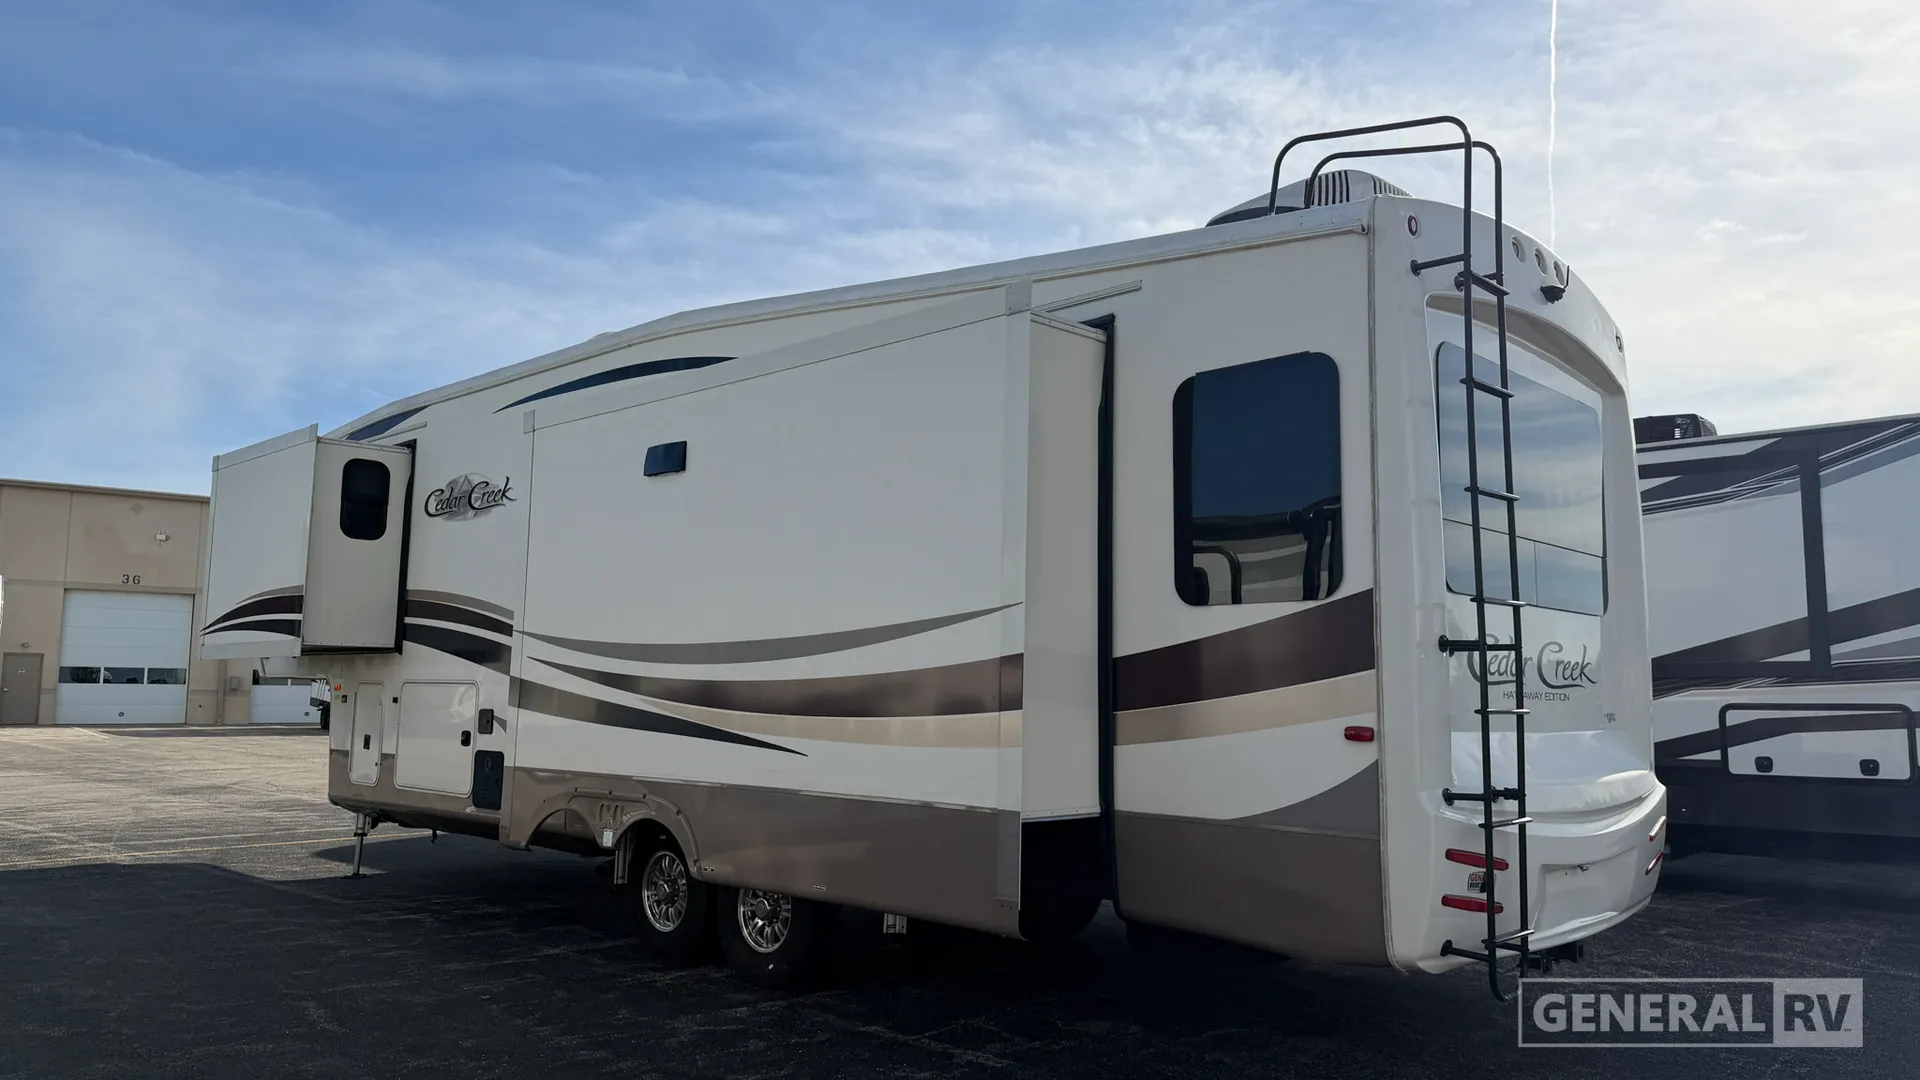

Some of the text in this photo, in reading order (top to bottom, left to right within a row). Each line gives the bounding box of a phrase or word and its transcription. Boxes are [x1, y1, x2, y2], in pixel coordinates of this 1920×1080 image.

[424, 475, 518, 517] Cedar Creek
[121, 574, 141, 585] 36
[1537, 641, 1597, 689] Creek
[1503, 690, 1570, 701] HAAWAY EDITION
